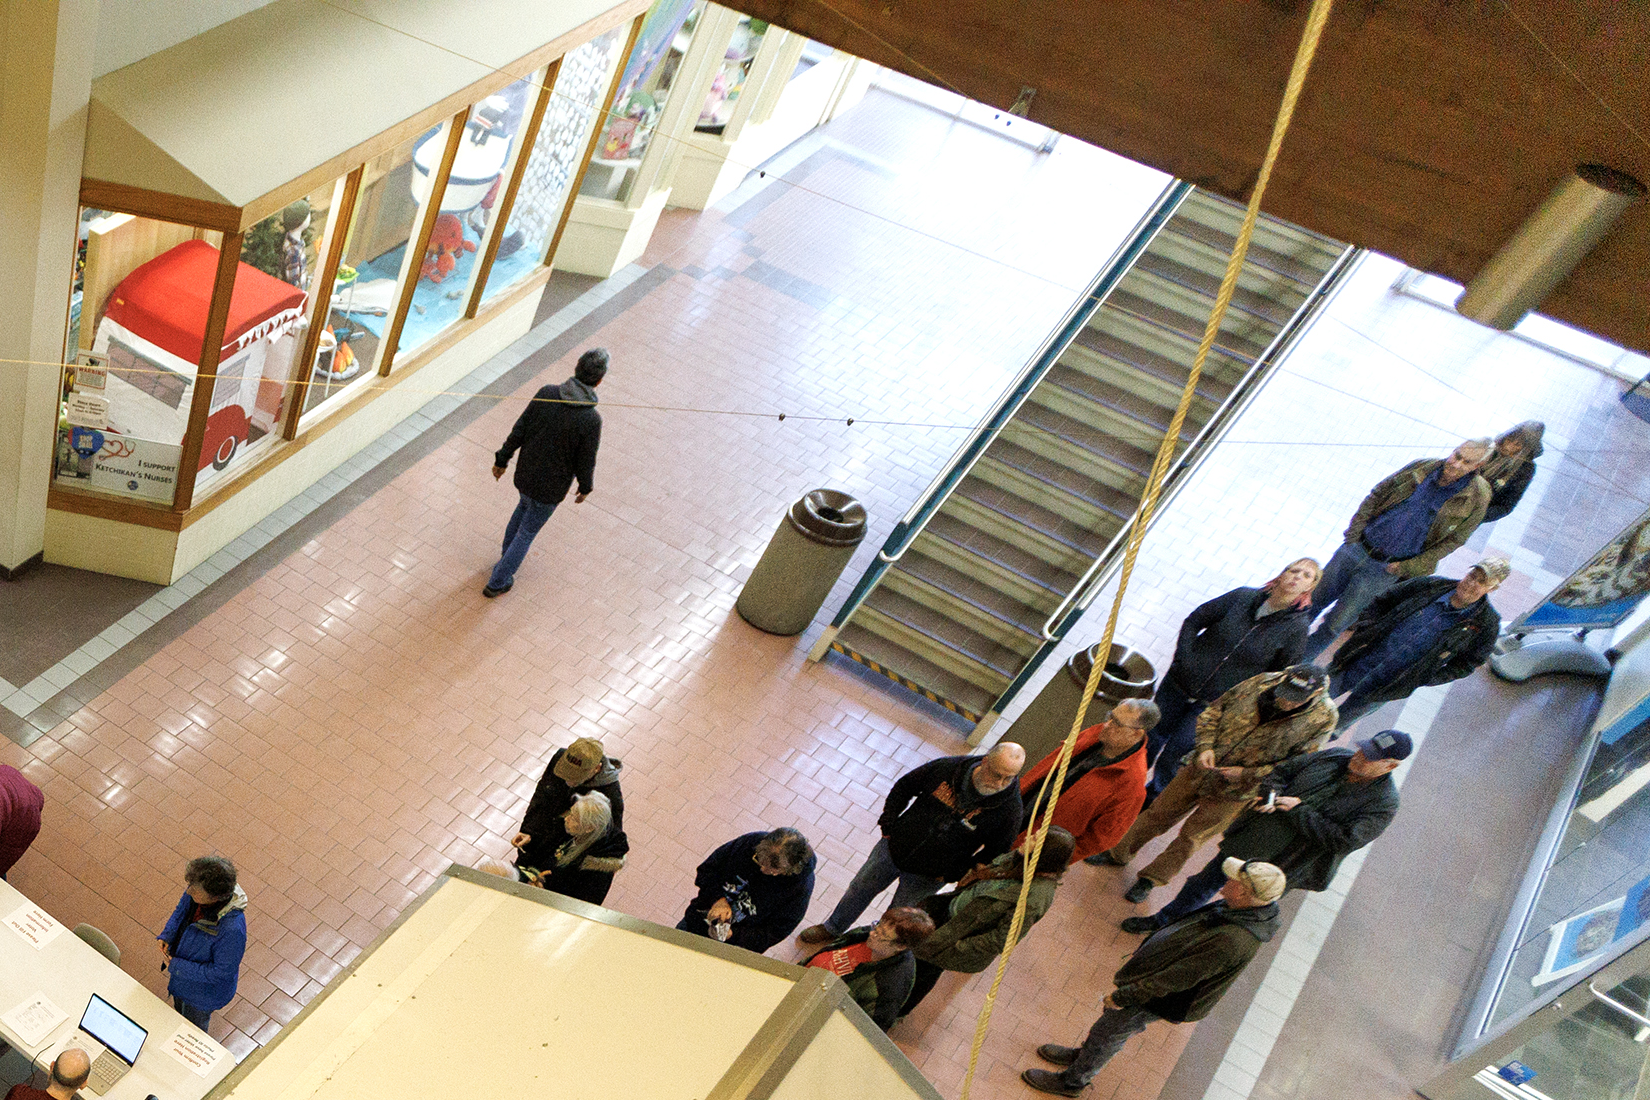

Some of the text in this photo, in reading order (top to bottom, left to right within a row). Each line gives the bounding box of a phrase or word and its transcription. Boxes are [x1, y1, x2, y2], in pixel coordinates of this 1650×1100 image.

[95, 463, 173, 484] KETCHIKAN'S NURSES
[138, 459, 176, 473] I SUPPORT
[26, 913, 49, 932] Information
[26, 932, 39, 943] Please
[184, 1054, 201, 1068] Confirm
[185, 1046, 210, 1065] Registration
